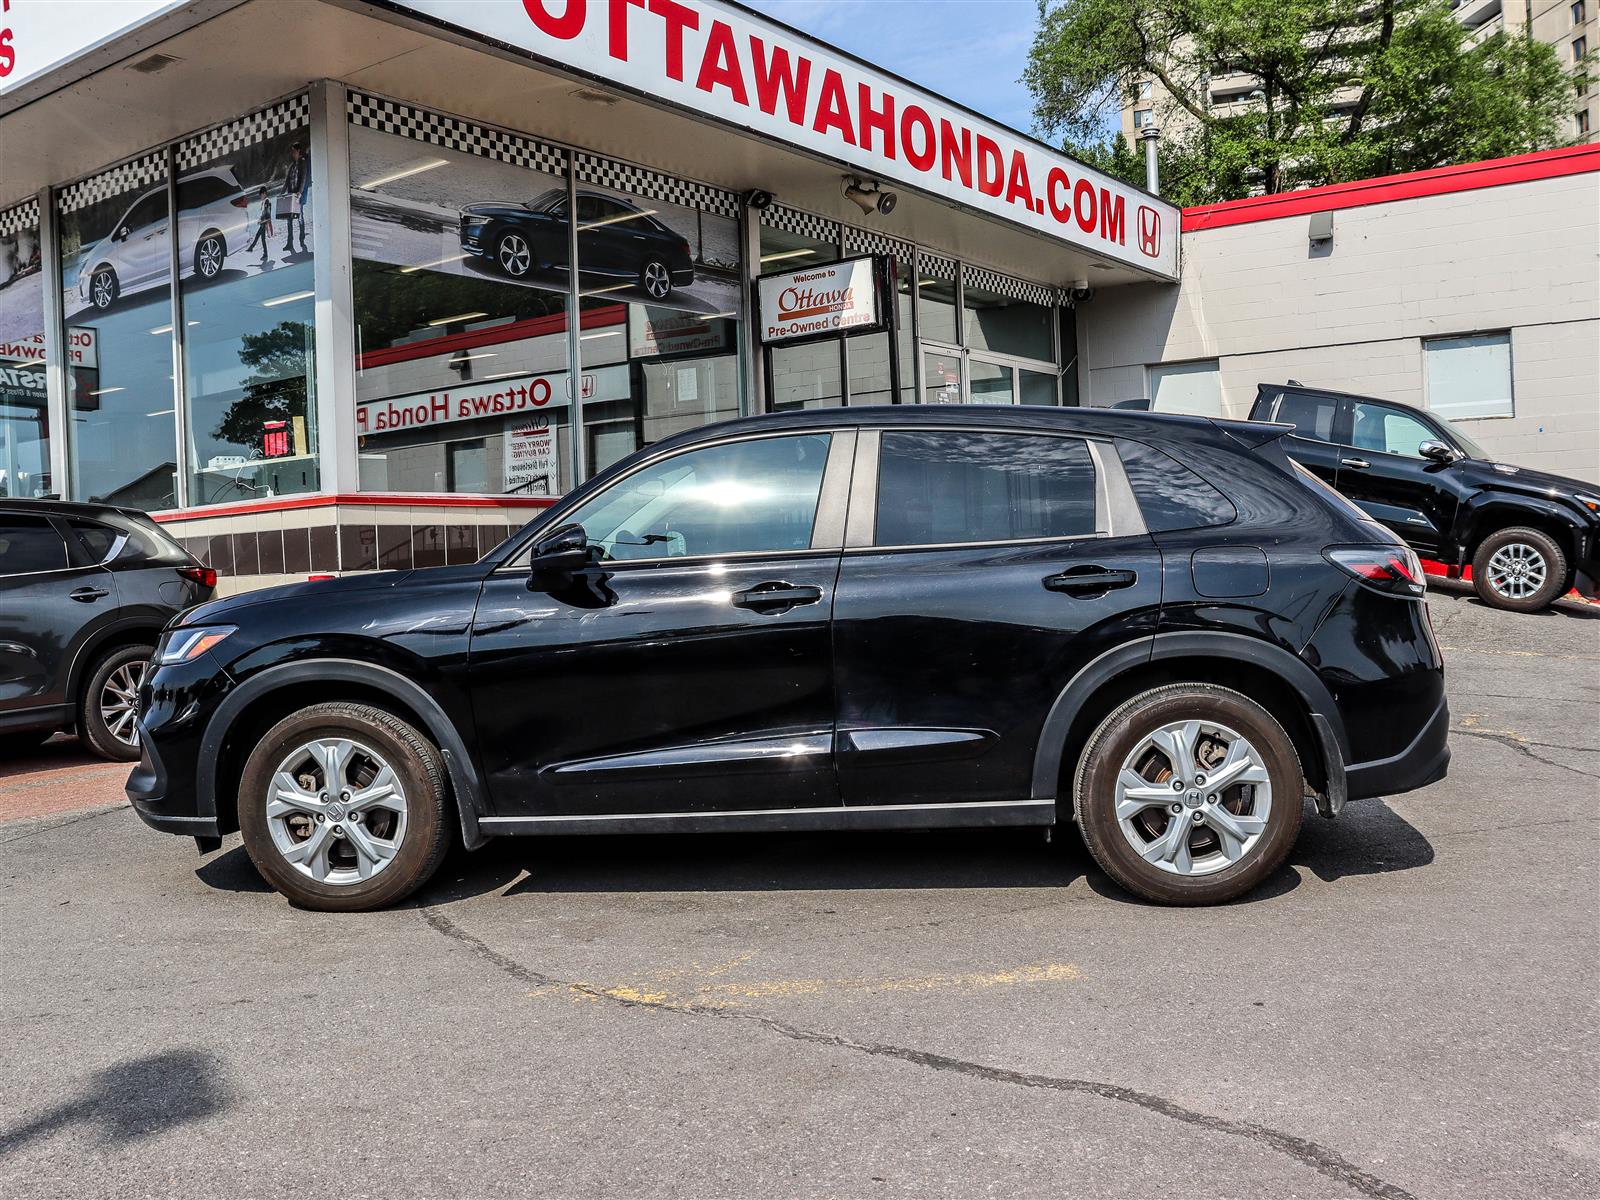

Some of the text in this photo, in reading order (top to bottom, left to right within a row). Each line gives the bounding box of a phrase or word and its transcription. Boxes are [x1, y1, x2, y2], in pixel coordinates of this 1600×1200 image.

[793, 271, 826, 284] Welcome
[778, 287, 854, 312] Ottawa
[829, 301, 853, 312] HONDA
[768, 312, 870, 338] Pre-Owned Centre
